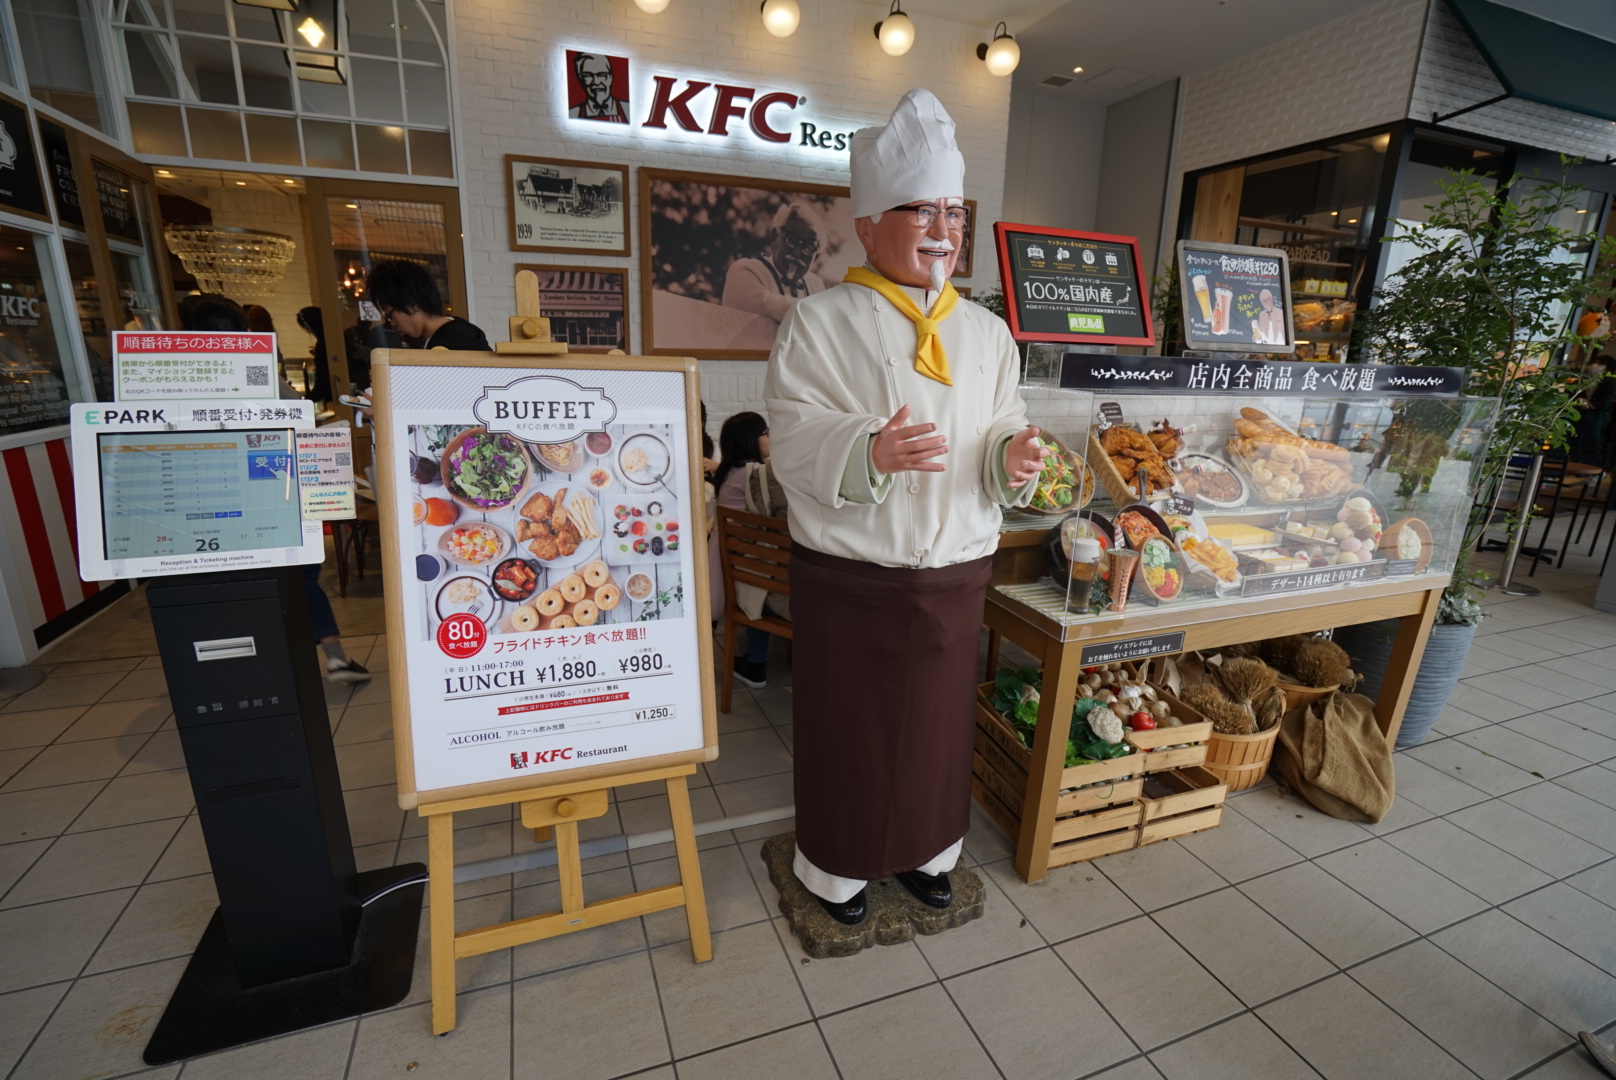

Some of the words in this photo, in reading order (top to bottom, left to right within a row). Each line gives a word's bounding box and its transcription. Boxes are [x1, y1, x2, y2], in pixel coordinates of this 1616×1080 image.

[642, 75, 799, 143] KFC
[516, 224, 532, 240] 1939
[1023, 282, 1114, 304] 100%国内産
[1, 295, 40, 318] KFC
[6, 317, 38, 326] Restaurant
[1070, 316, 1103, 330] 鹿児島県
[123, 336, 268, 350] 順番待ちのお客様へ
[1187, 363, 1293, 392] 店内全商品
[1301, 366, 1378, 392] 食べ放題
[192, 408, 303, 422] 順番受付・発券機
[494, 401, 595, 420] BUFFET
[516, 422, 575, 431] KFCの食べ放題
[195, 538, 220, 552] 26
[1270, 568, 1367, 590] デザート14種以上有ります
[448, 641, 478, 650] 食べ放題
[493, 627, 646, 654] フライドチキン食べ放題!!
[1114, 640, 1152, 650] ディスプレイには
[472, 660, 524, 672] 11:00-17:00
[536, 660, 596, 683] ¥1,880
[619, 653, 662, 674] ¥980
[444, 670, 525, 694] LUNCH
[450, 732, 501, 746] ALCOHOL
[506, 723, 565, 737] アルコール飲み放題
[533, 747, 573, 764] KFC
[577, 745, 628, 759] Restaurant
